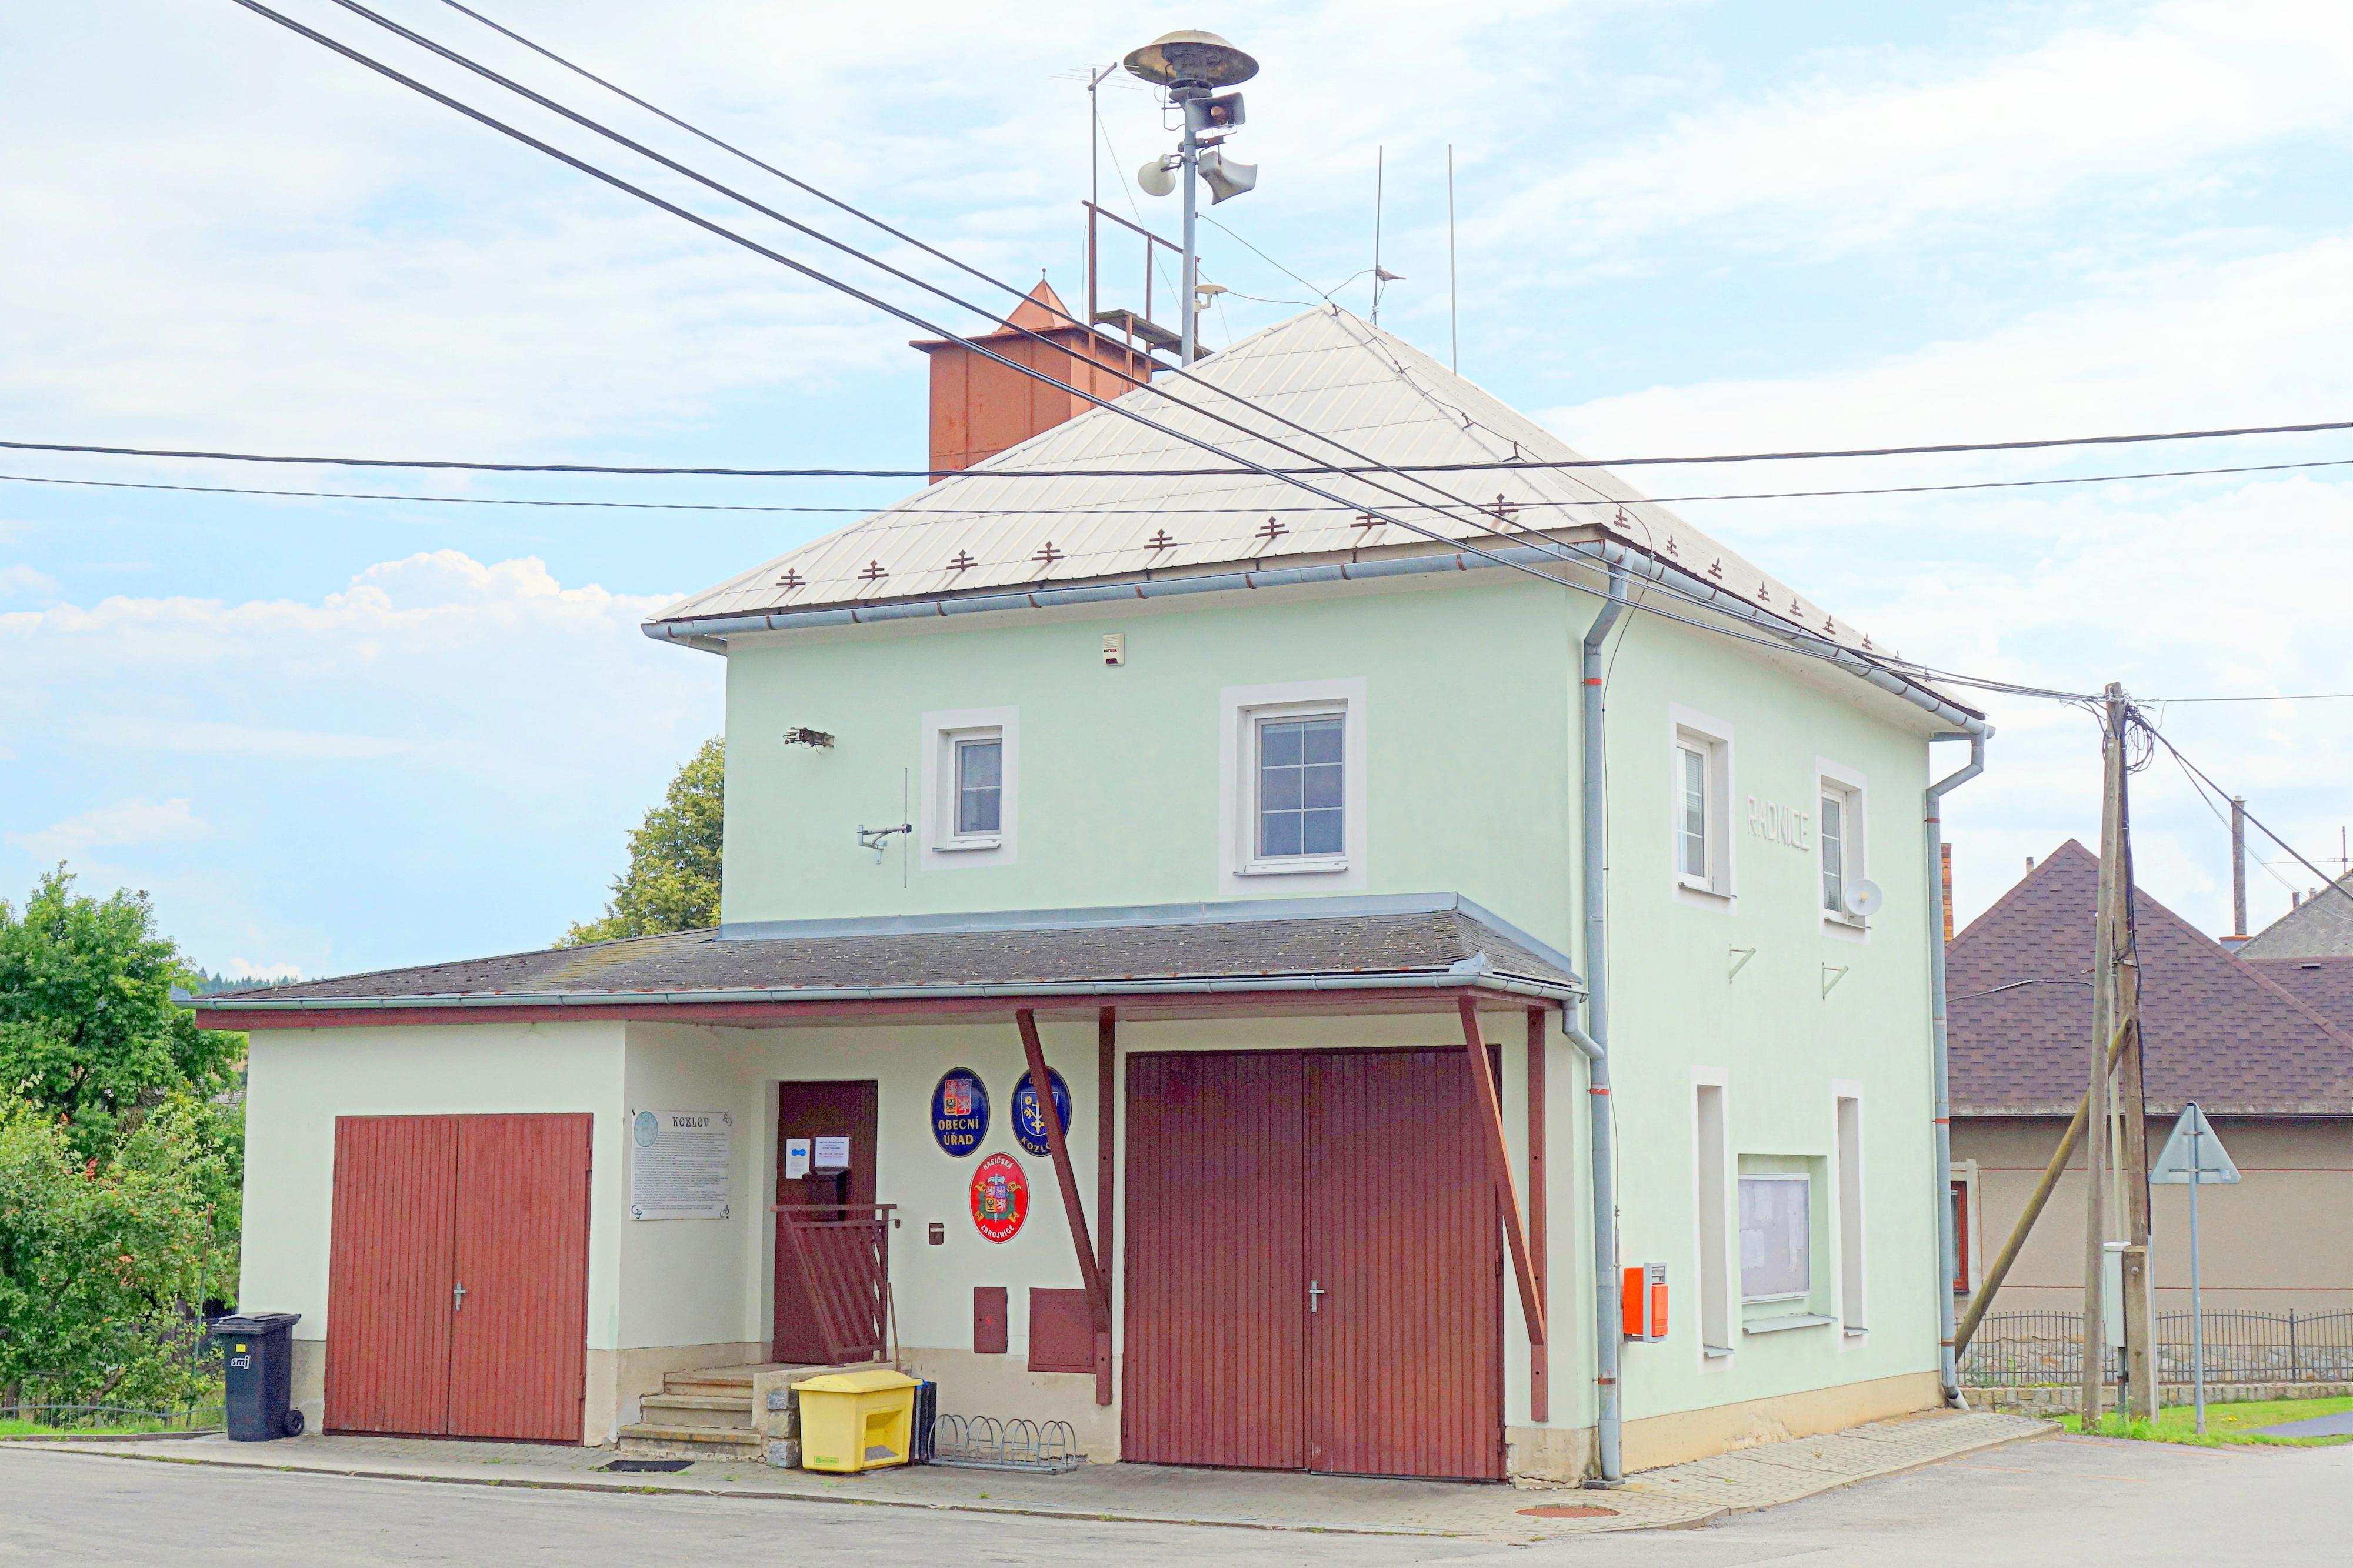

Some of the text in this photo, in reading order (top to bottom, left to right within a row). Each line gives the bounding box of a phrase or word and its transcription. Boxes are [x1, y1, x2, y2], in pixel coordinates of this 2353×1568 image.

[1748, 795, 1810, 851] RADNICE
[672, 1116, 709, 1127] KOZLOV
[938, 1116, 979, 1130] OBECNÍ
[944, 1132, 974, 1145] ÚŘAD
[1021, 1136, 1051, 1153] KOZLO
[983, 1156, 1014, 1170] HASIČSKÁ
[981, 1224, 1015, 1239] ZBROJNICE
[232, 1356, 248, 1368] smj
